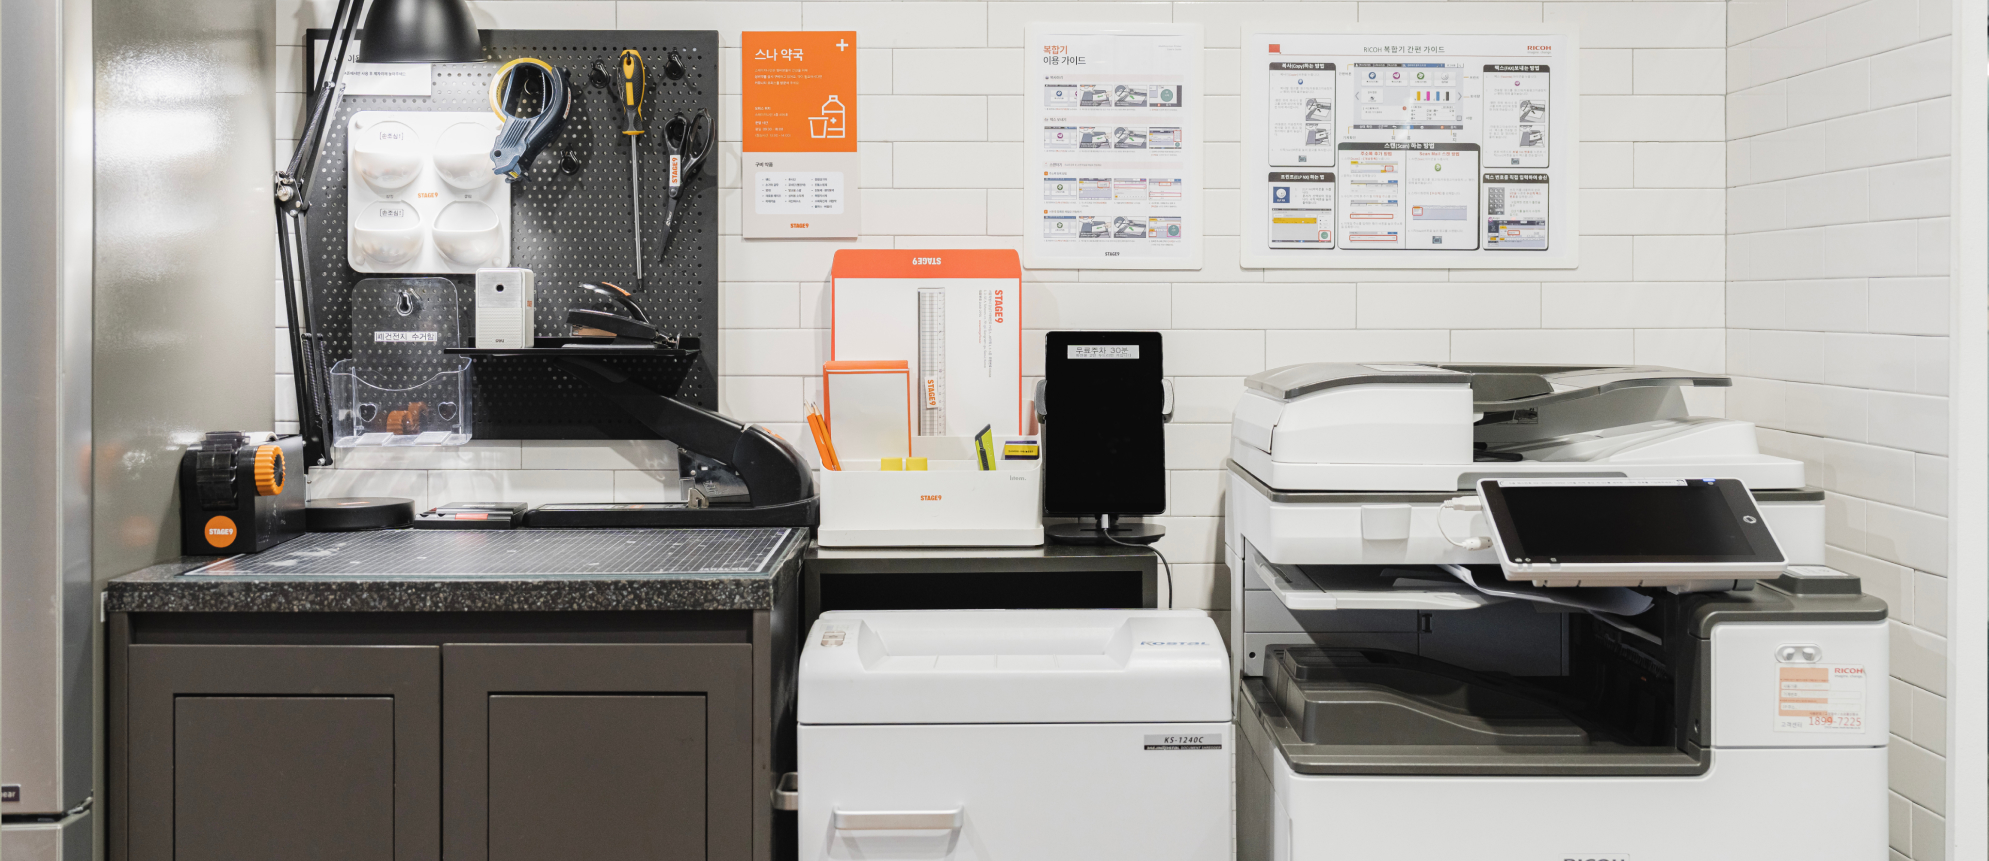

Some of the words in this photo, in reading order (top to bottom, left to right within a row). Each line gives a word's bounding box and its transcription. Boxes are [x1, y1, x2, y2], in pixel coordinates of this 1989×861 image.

[1043, 45, 1068, 54] 복합기
[1407, 46, 1421, 54] 간편
[1423, 46, 1445, 54] 가이드
[755, 48, 778, 61] 스나
[781, 48, 804, 61] 약국
[1043, 56, 1059, 65] 이용
[1061, 56, 1086, 65] 가이드
[912, 257, 942, 265] STAGE9
[994, 289, 1003, 323] STAGE9
[1076, 346, 1106, 355] 무료주차
[1110, 346, 1129, 355] 30분
[927, 379, 936, 406] STAGE9
[1809, 716, 1862, 727] 1899-7225
[1164, 736, 1204, 744] KS-1240C
